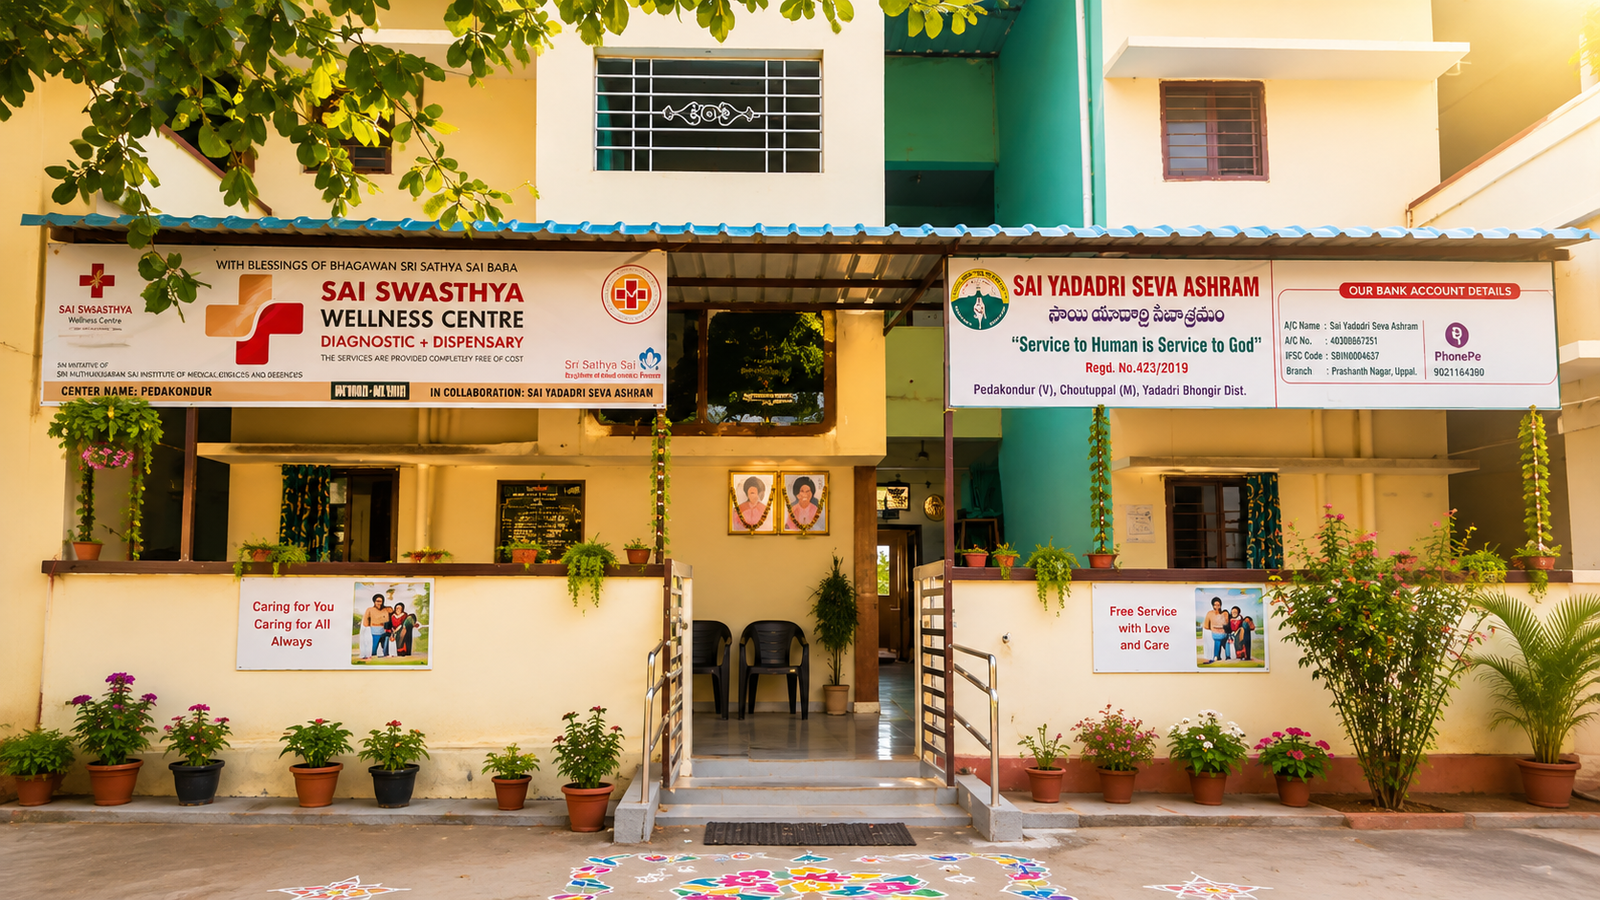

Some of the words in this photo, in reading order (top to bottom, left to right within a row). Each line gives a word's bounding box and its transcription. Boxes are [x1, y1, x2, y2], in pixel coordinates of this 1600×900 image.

[216, 260, 244, 270] WITH
[248, 260, 308, 270] BLESSINGS
[311, 261, 326, 270] OF
[330, 260, 396, 271] BHAGAWAN
[401, 262, 416, 271] SRI
[420, 262, 462, 272] SATHYA
[466, 262, 483, 272] SAI
[321, 281, 365, 302] SAI
[376, 281, 524, 303] SWASTHYA
[1014, 275, 1042, 296] SAI
[1049, 275, 1125, 296] YADADRI
[1132, 275, 1177, 296] SEVA
[1183, 276, 1259, 297] ASHRAM
[1349, 286, 1373, 295] OUR
[1377, 286, 1407, 296] BANK
[1411, 286, 1465, 296] ACCOUNT
[1468, 287, 1511, 296] DETAILS
[59, 305, 74, 314] SAI
[1049, 306, 1088, 323] సాయి
[321, 309, 433, 328] WELLNESS
[442, 310, 524, 328] CENTRE
[1284, 321, 1297, 330] A/C
[1299, 322, 1320, 330] Name
[1330, 322, 1341, 330] Sai
[1372, 322, 1389, 330] Seva
[1391, 322, 1418, 330] Ashram
[321, 336, 415, 348] DIAGNOSTIC
[433, 336, 524, 349] DISPENSARY
[1074, 338, 1087, 352] to
[1092, 337, 1138, 353] Human
[1142, 337, 1154, 353] is
[1158, 338, 1207, 353] Service
[1211, 338, 1224, 353] to
[391, 354, 428, 362] PROVIDED
[1304, 352, 1322, 360] Code
[1435, 351, 1481, 361] PhonePe
[583, 360, 617, 372] Sathya
[621, 360, 635, 369] Sai
[1086, 363, 1115, 375] Regd.
[1119, 363, 1188, 375] No.423/2019
[1287, 367, 1312, 375] Branch
[1332, 367, 1368, 375] Prashanth
[1370, 367, 1393, 377] Nagar,
[1395, 368, 1417, 377] Uppal.
[62, 386, 100, 395] CENTER
[104, 386, 137, 396] NAME:
[142, 386, 212, 396] PEDAKONDUR
[430, 388, 440, 397] IN
[444, 388, 524, 397] COLLABORATION:
[528, 388, 542, 398] SAI
[546, 388, 586, 398] YADADRI
[589, 388, 611, 397] SEVA
[974, 384, 1035, 396] Pedakondur
[1038, 384, 1056, 397] (V),
[1060, 384, 1116, 398] Choutuppal
[1119, 385, 1139, 398] (M),
[1142, 385, 1180, 396] Yadadri
[1183, 385, 1220, 398] Bhongir
[1224, 385, 1247, 396] Dist.
[253, 602, 290, 614] Caring
[294, 601, 310, 611] for
[314, 602, 334, 611] You
[1110, 606, 1133, 616] Free
[1137, 606, 1177, 616] Service
[254, 619, 292, 631] Caring
[296, 619, 312, 629] for
[315, 619, 330, 629] All
[1119, 623, 1141, 633] with
[1145, 624, 1170, 633] Love
[271, 637, 312, 649] Always
[1120, 640, 1140, 650] and
[1144, 641, 1169, 650] Care
